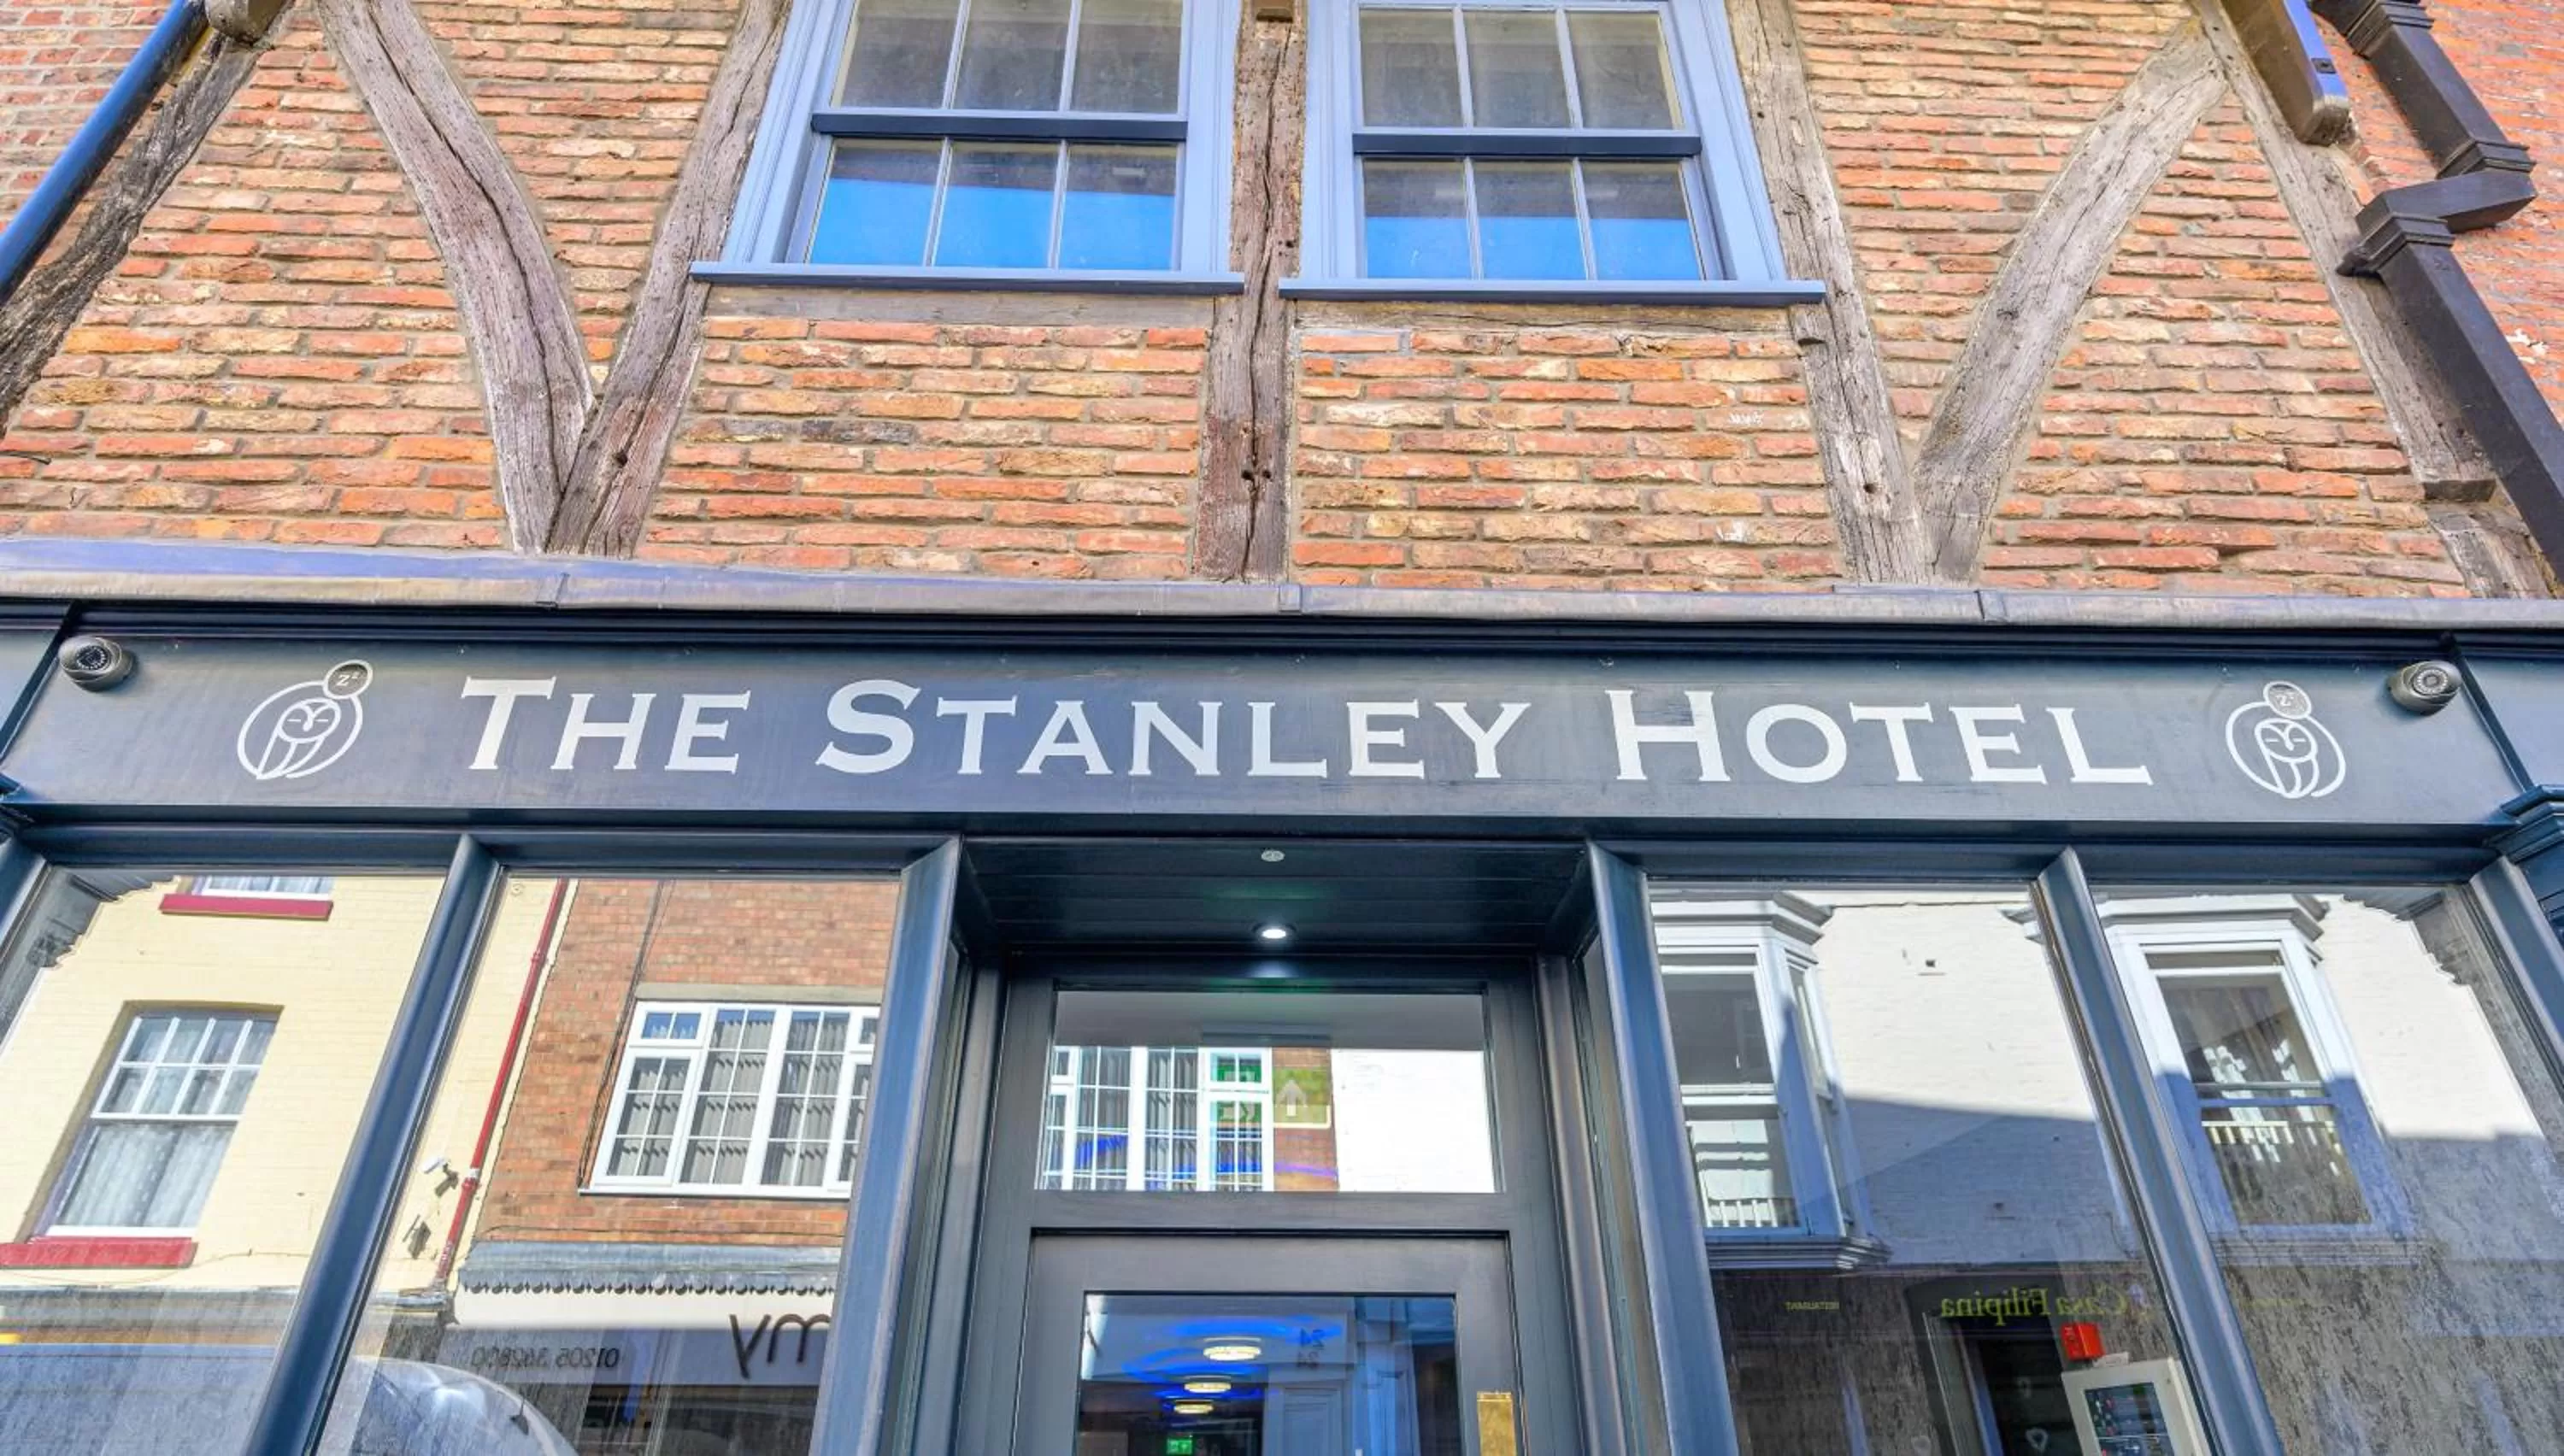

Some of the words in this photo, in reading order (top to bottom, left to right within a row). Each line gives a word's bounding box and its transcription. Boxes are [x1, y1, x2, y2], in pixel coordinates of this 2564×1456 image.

[461, 676, 751, 775] THE
[814, 679, 1532, 782] STANLEY
[1604, 690, 2155, 787] HOTEL
